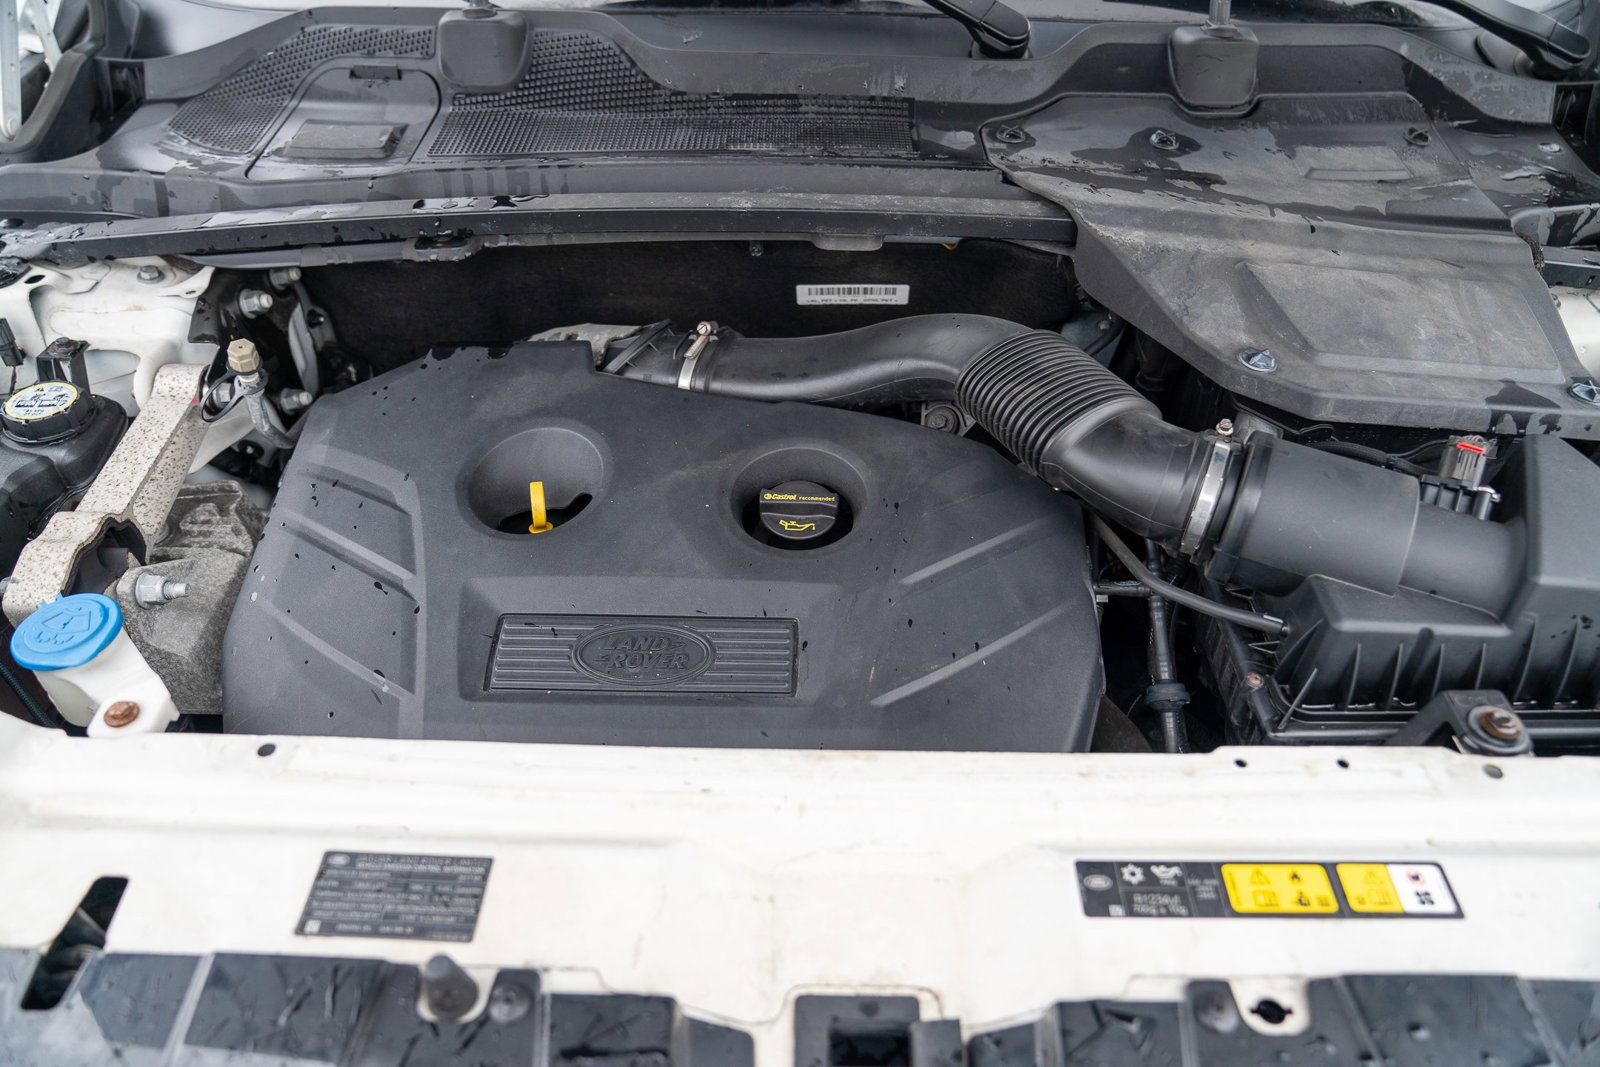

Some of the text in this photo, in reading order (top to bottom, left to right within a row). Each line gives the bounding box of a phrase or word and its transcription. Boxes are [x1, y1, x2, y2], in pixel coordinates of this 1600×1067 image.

[771, 493, 797, 501] Castrol
[604, 636, 672, 652] LAND
[606, 652, 690, 670] ROVER
